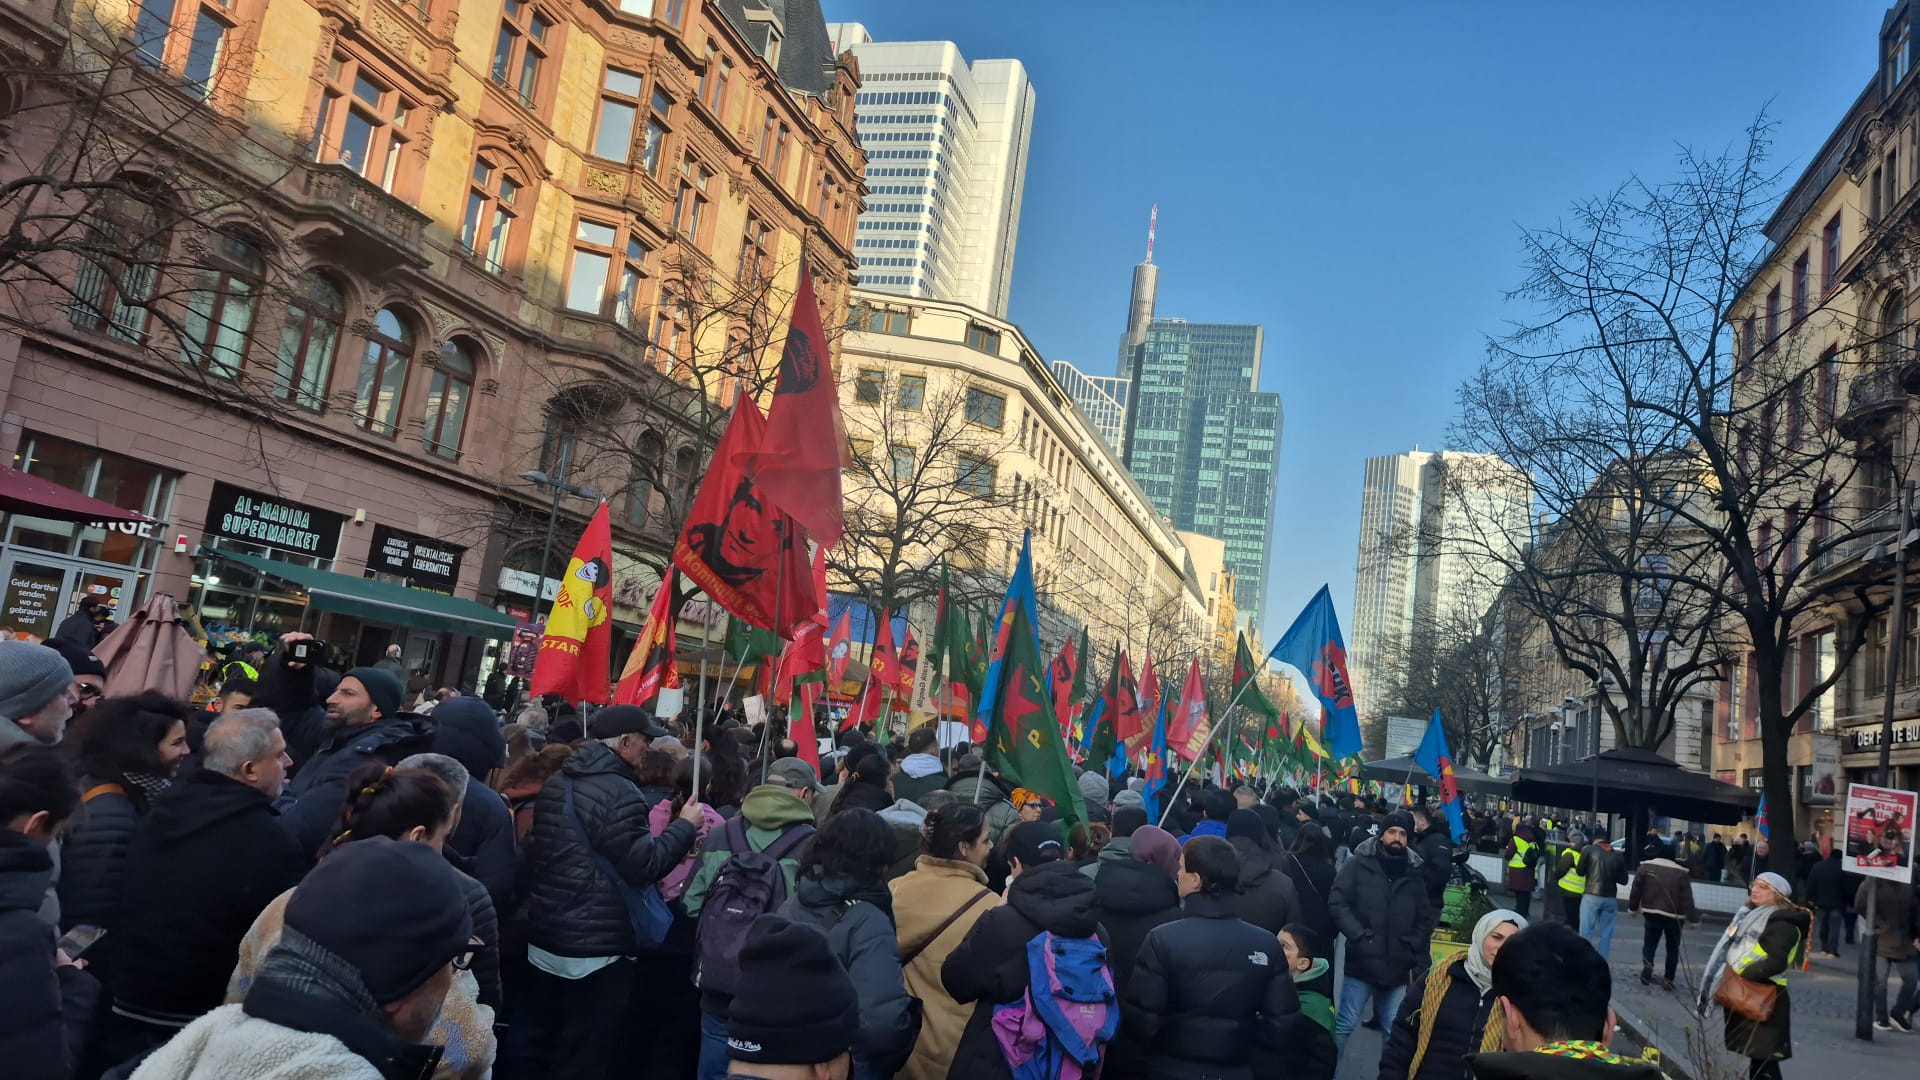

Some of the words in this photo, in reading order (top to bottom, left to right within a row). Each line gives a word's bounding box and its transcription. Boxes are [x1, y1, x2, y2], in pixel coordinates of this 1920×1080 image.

[235, 495, 310, 529] AL-MADINA
[222, 513, 320, 551] SUPERMARKET
[414, 545, 455, 564] ORIENTALISCHE
[412, 558, 451, 577] LEBENSMITTEL
[11, 578, 30, 588] Geld
[30, 580, 59, 593] dorthin
[9, 605, 48, 617] gebraucht
[19, 599, 30, 607] wo
[18, 616, 36, 624] wird
[1857, 731, 1874, 746] DER
[1876, 727, 1903, 745] FTE
[1905, 725, 1920, 742] BU
